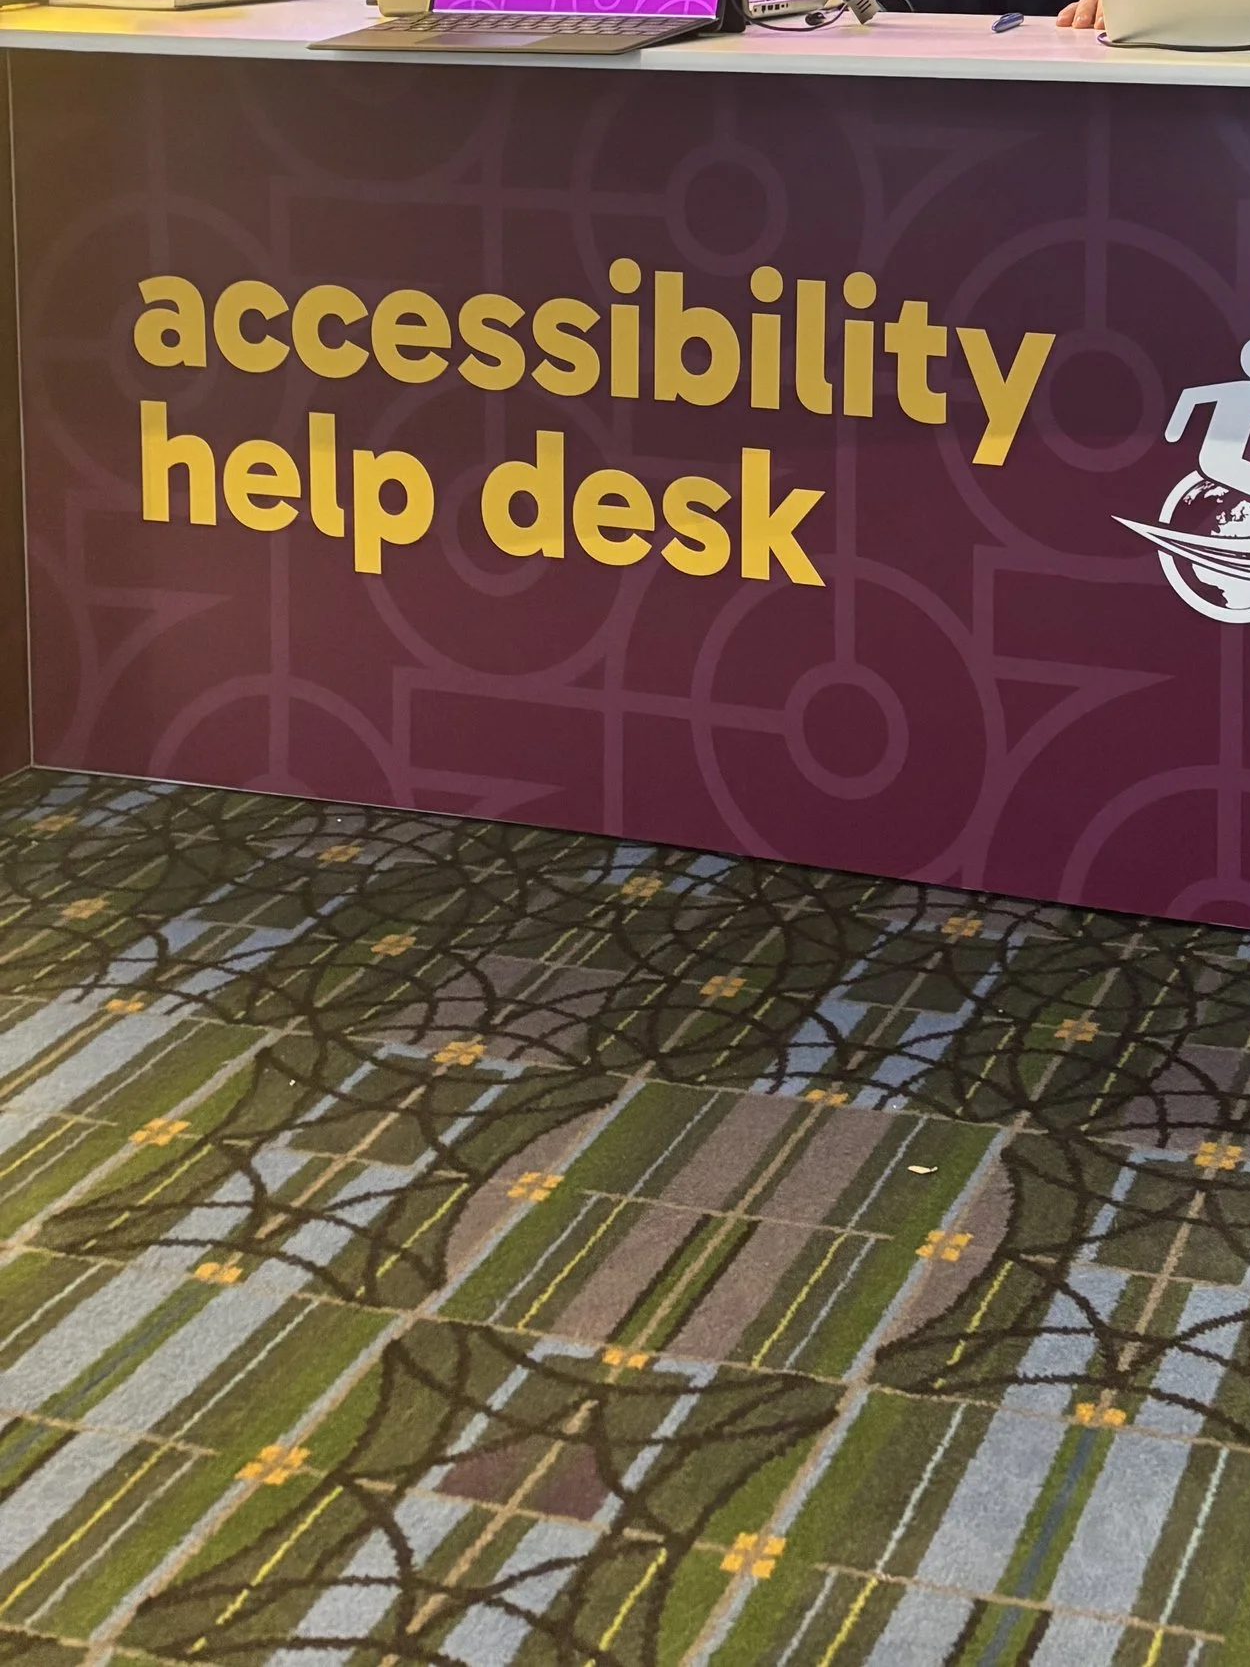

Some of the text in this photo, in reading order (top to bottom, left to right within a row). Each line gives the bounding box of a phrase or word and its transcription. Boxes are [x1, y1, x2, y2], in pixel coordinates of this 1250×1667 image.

[134, 257, 1056, 467] accessibility
[141, 400, 826, 586] help desk
